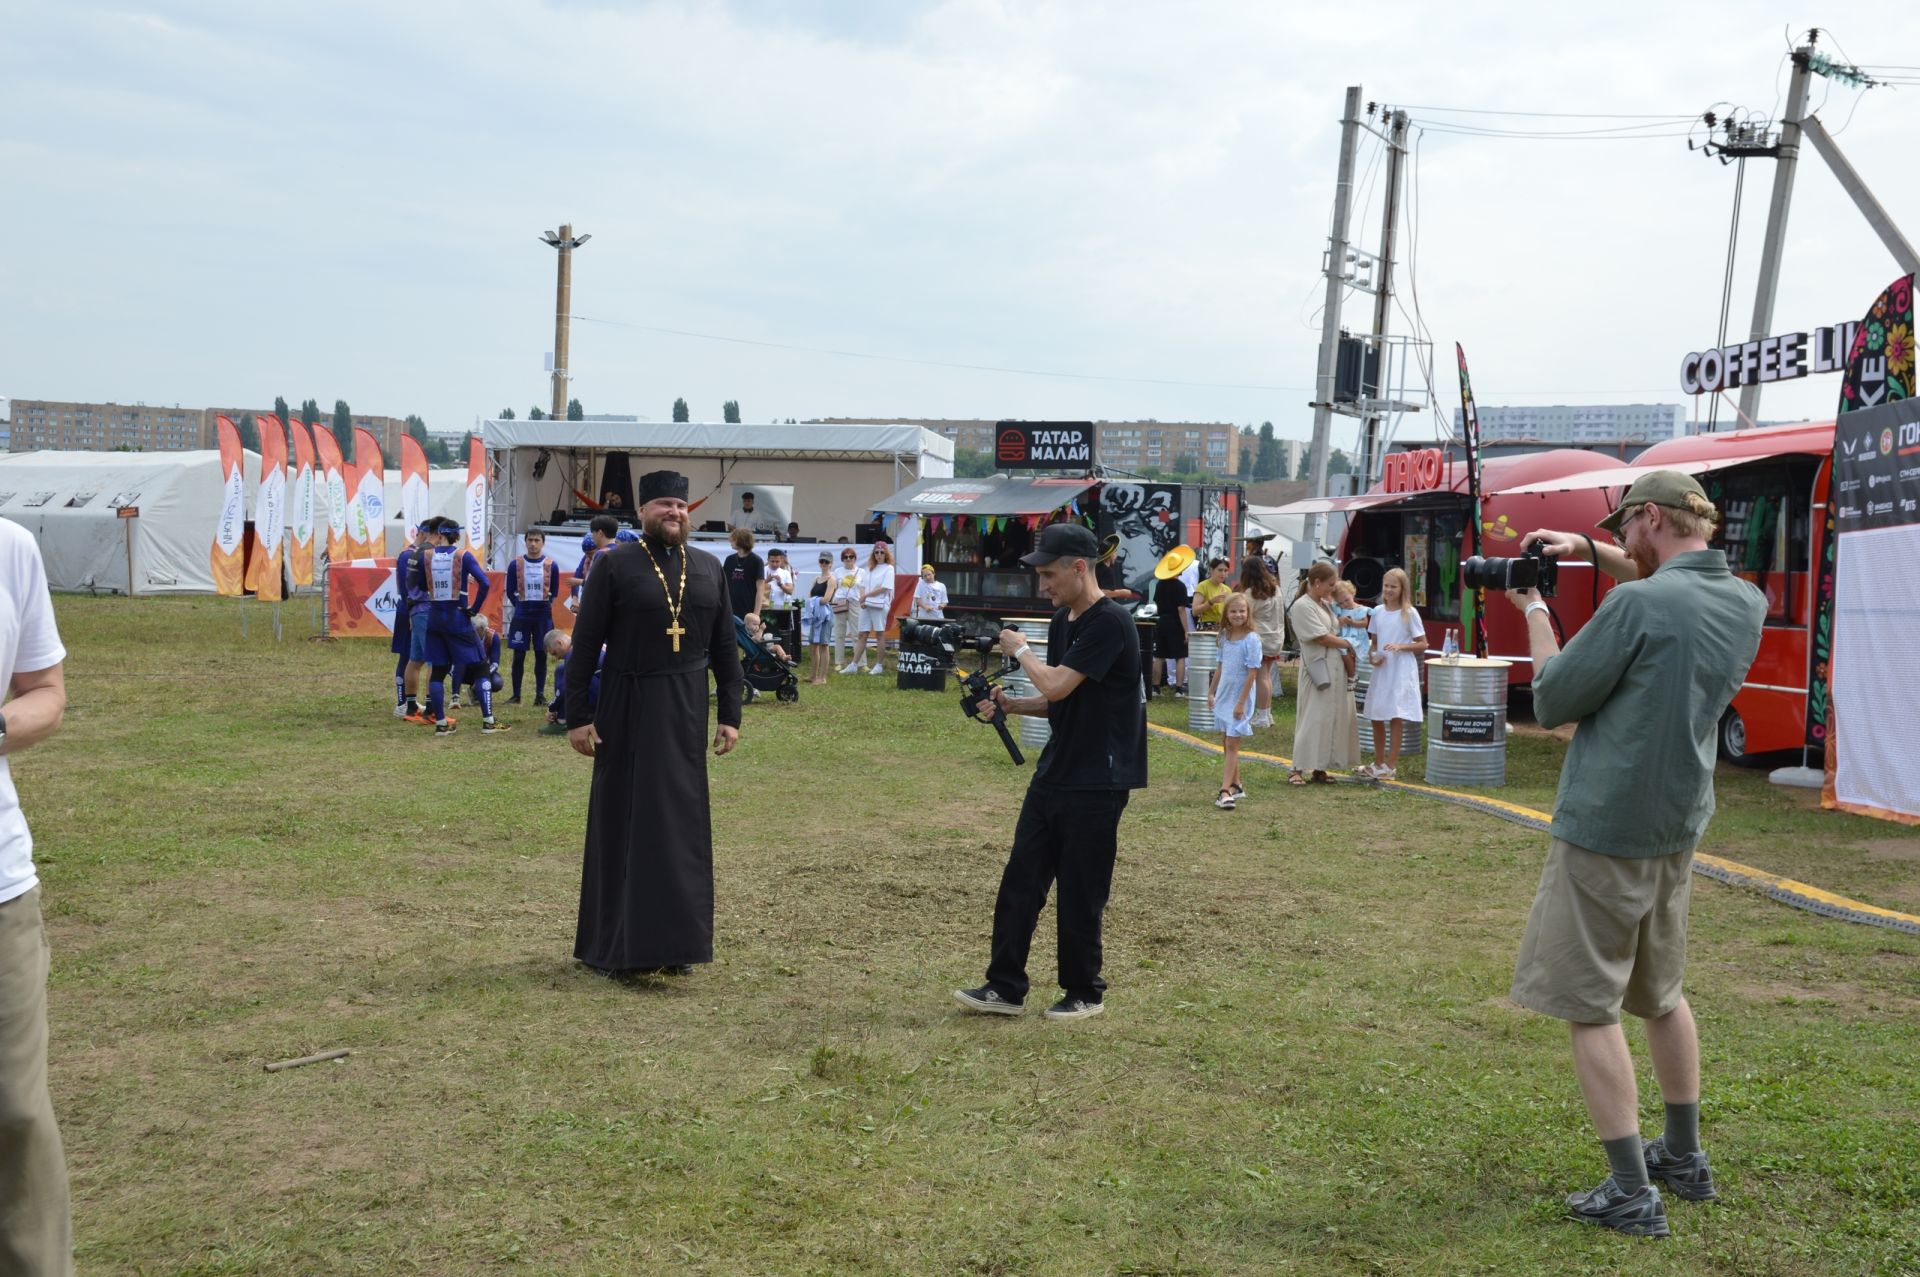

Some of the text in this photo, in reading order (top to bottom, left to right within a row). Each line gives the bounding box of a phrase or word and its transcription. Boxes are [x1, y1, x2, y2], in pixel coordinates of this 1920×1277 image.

[1681, 333, 1804, 395] COFFEE
[1031, 430, 1082, 445] ТАТАР
[1031, 443, 1090, 461] МАЛАЙ
[1384, 448, 1443, 494] ПАКО
